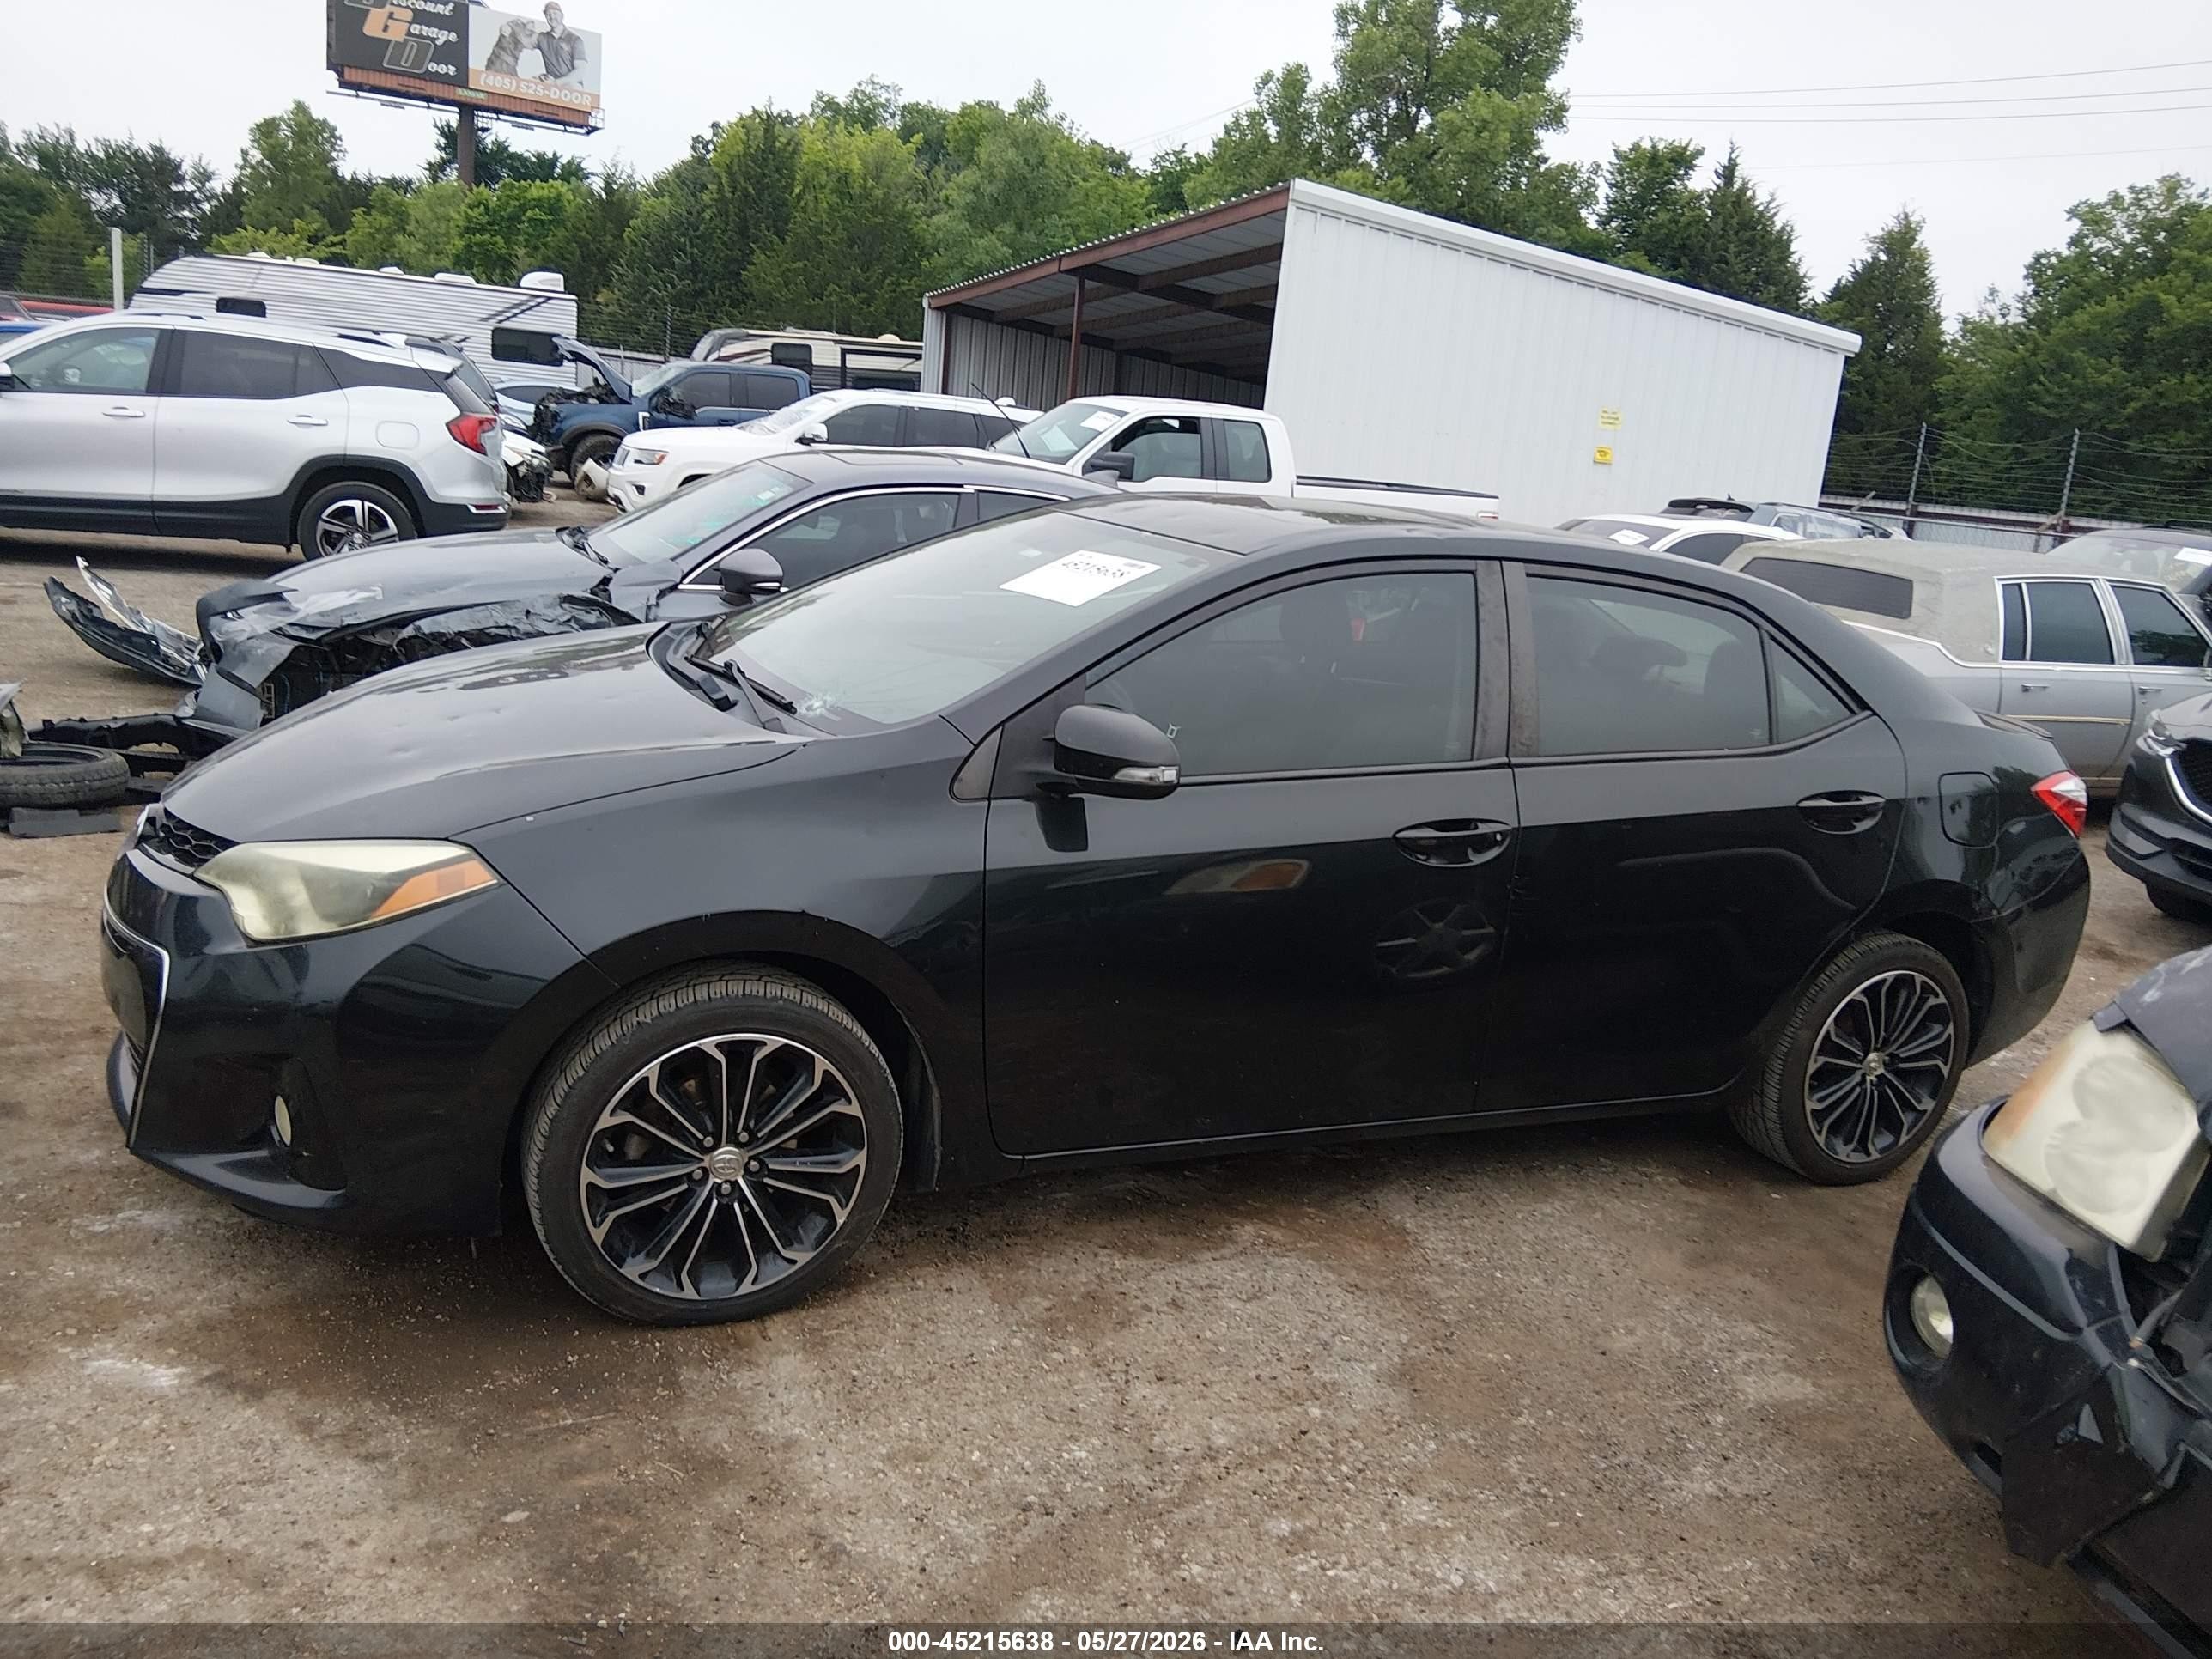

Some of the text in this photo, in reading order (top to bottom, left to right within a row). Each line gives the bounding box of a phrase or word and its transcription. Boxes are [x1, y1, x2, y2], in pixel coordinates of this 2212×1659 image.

[362, 4, 459, 46] Garage
[480, 73, 592, 105] (405) 525-DOOR
